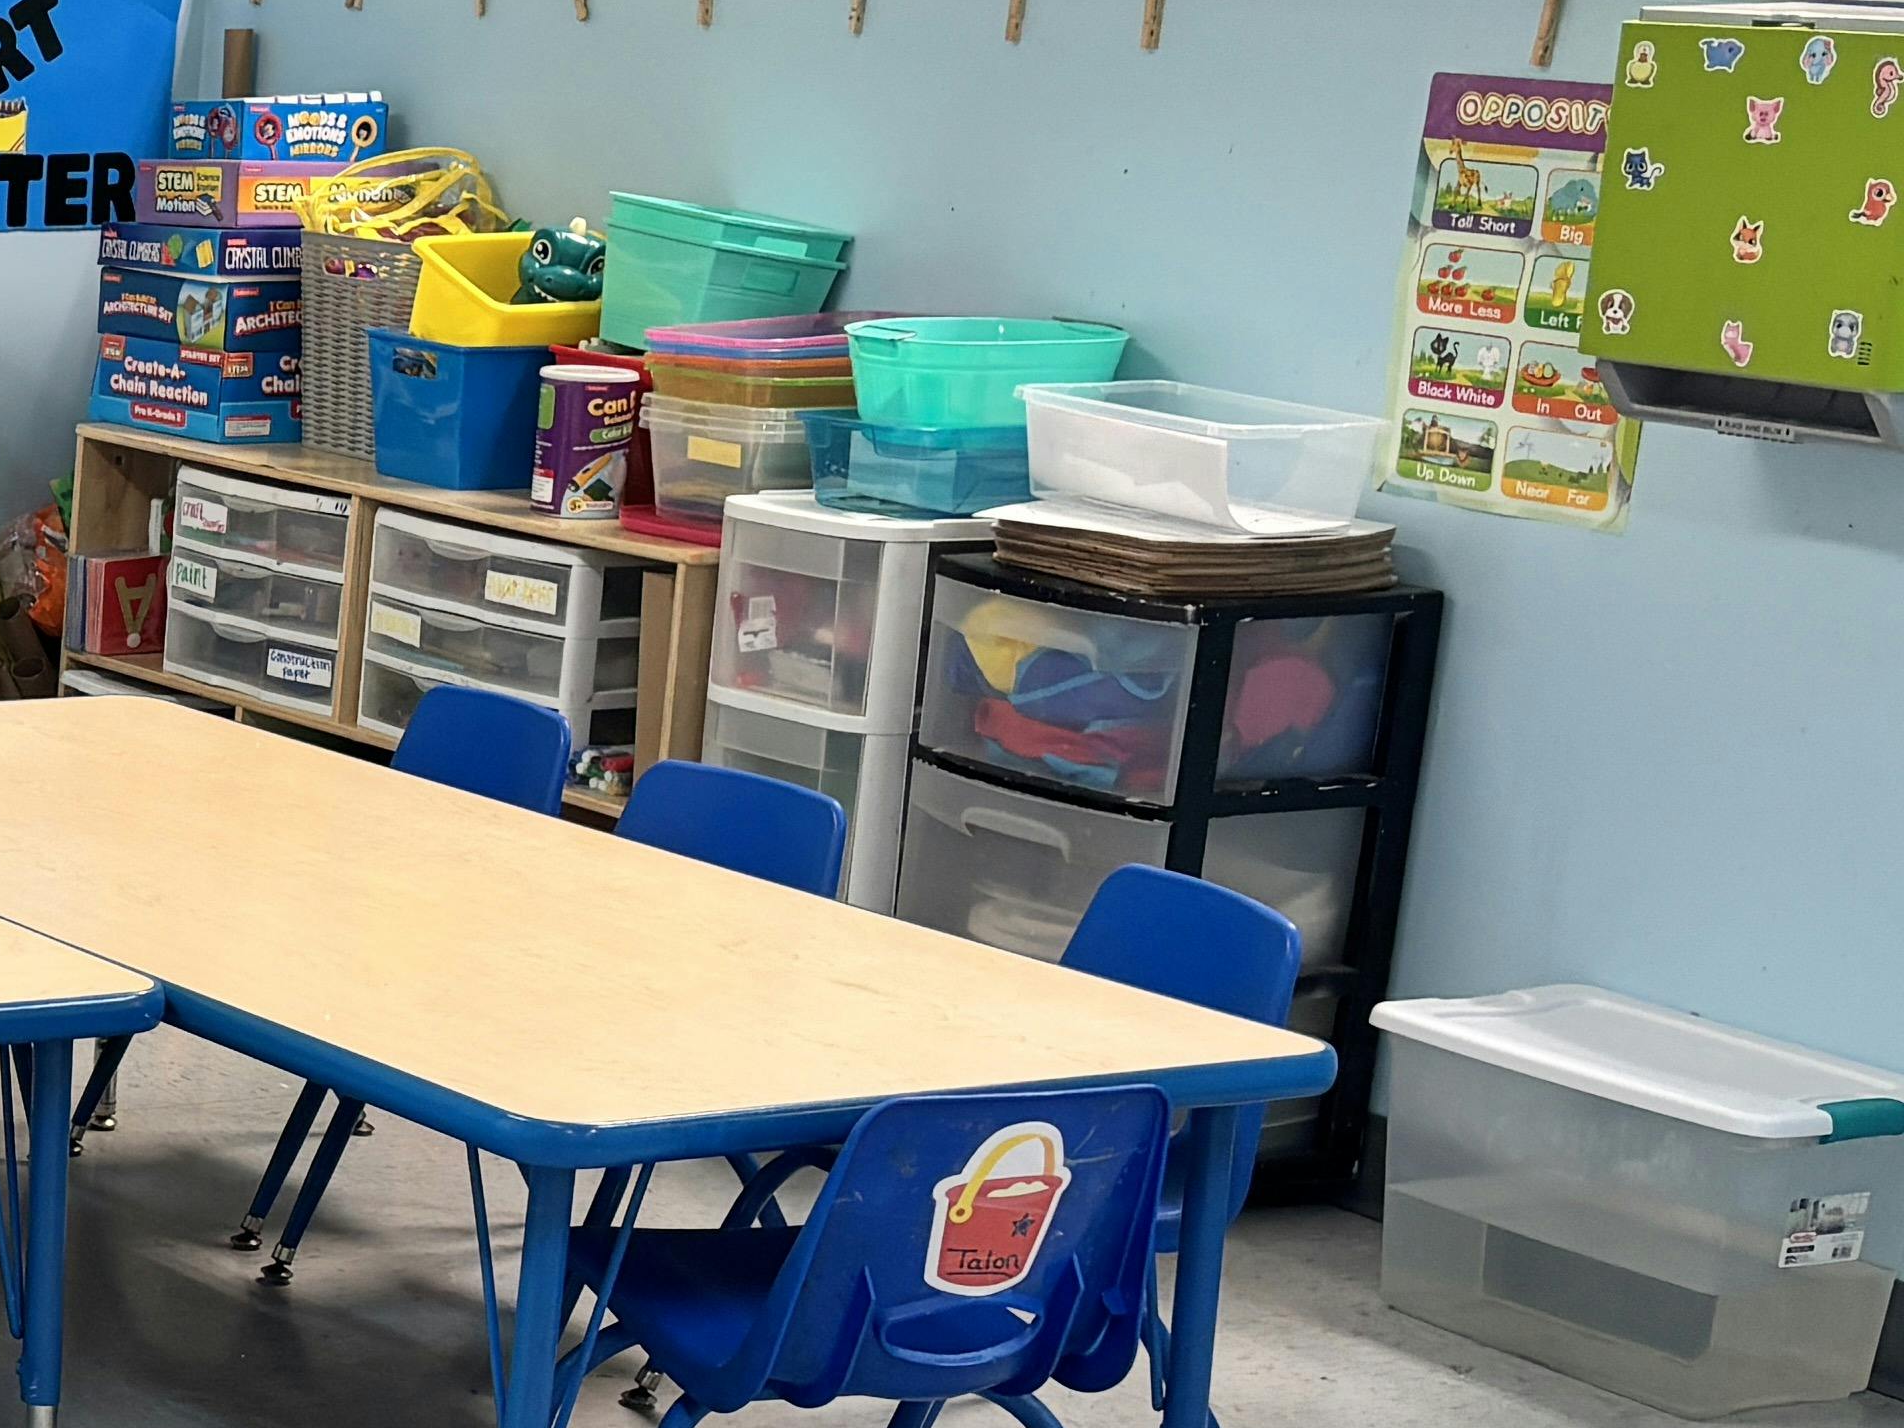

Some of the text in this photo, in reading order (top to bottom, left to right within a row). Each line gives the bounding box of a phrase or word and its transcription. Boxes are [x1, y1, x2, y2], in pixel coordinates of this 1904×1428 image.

[286, 127, 346, 144] EMOTIONS
[157, 171, 194, 192] STEM
[255, 183, 304, 202] STEM
[156, 197, 196, 213] Motion
[1451, 213, 1516, 234] Tall Short
[1560, 226, 1584, 245] Big
[225, 246, 269, 270] CRYSTAL
[1428, 296, 1501, 319] More Less
[1541, 311, 1569, 328] Left
[124, 356, 186, 380] Create-A-
[110, 375, 208, 406] Chain Reaction
[1418, 380, 1495, 406] Black White
[588, 398, 628, 417] Can
[1537, 399, 1603, 422] In Out
[1417, 464, 1476, 487] Up Down
[1515, 480, 1590, 506] Near Far
[947, 1248, 1021, 1270] Talon
